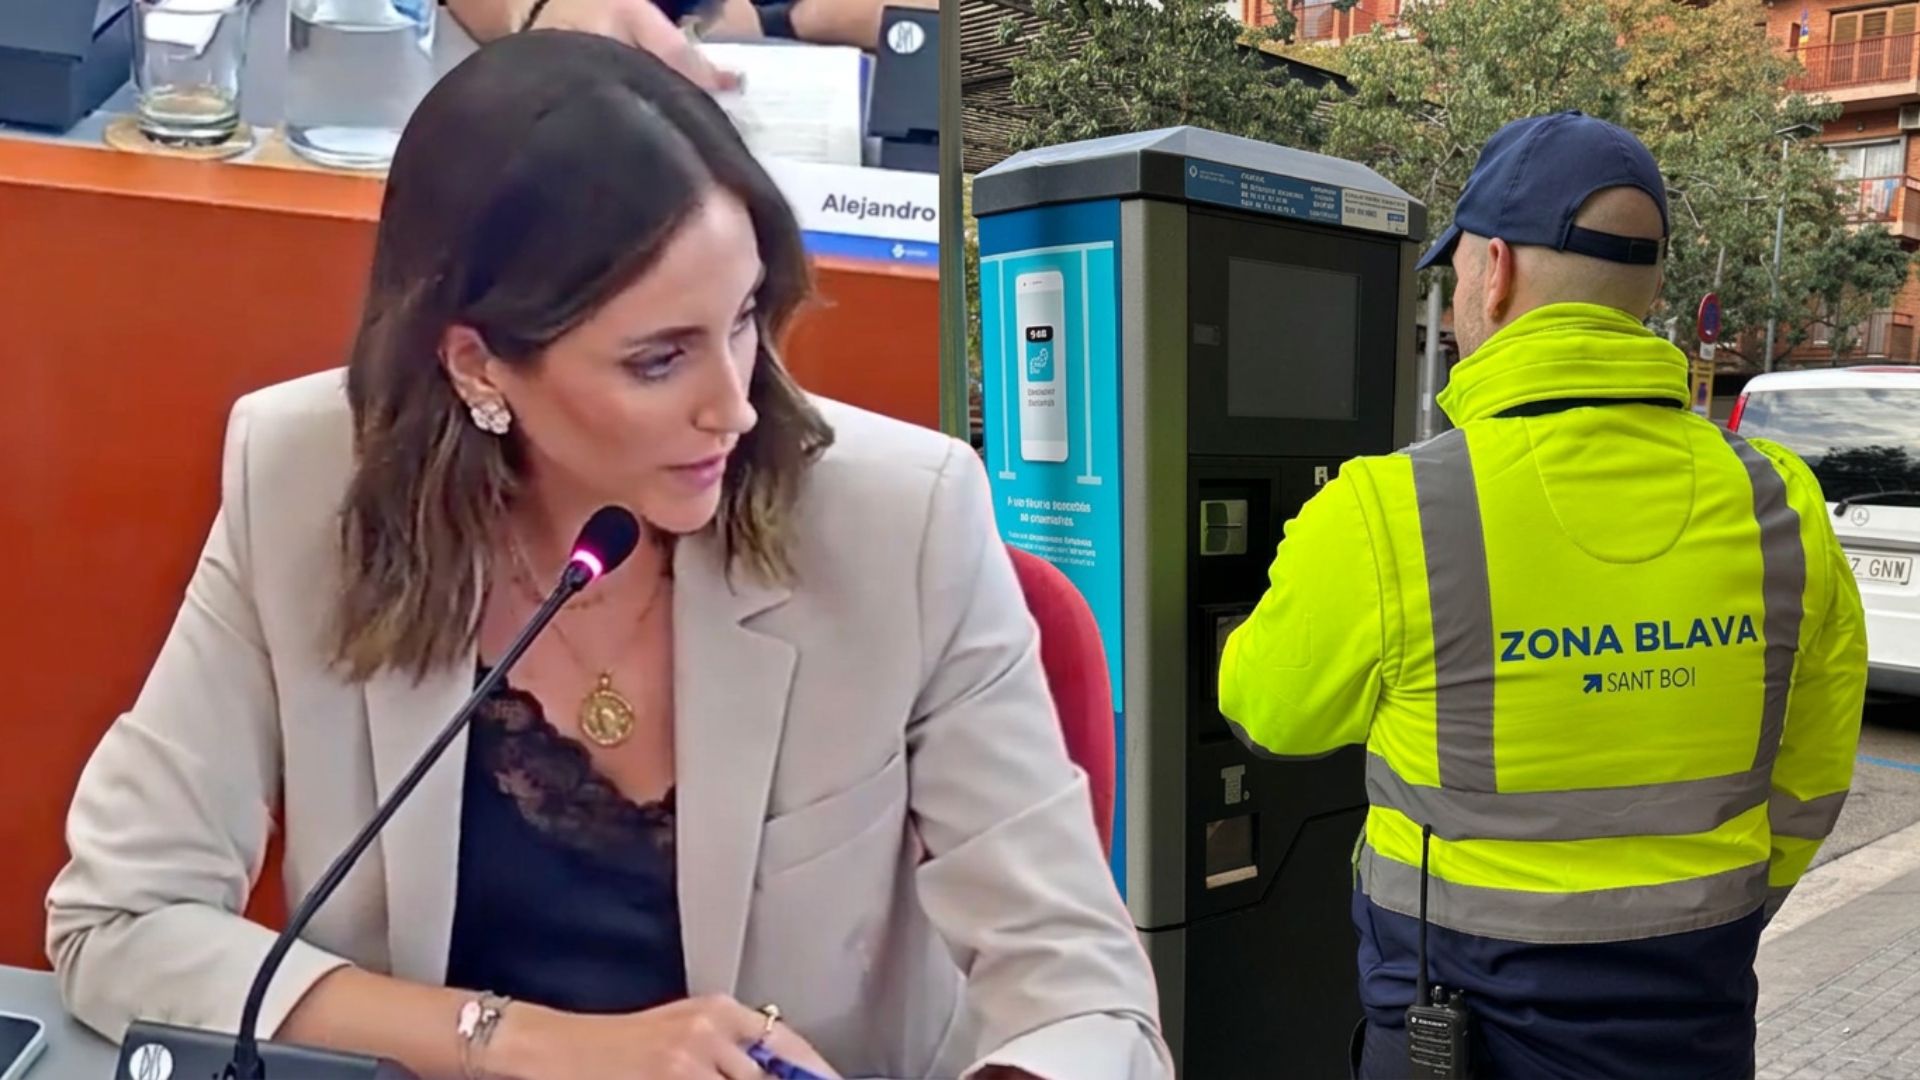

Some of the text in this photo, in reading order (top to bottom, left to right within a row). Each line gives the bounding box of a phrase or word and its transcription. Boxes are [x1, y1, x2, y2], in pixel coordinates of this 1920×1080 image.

[821, 193, 936, 222] Alejandro
[1869, 559, 1905, 579] GNN
[1500, 614, 1758, 663] ZONA BLAVA
[1606, 666, 1696, 693] SANT BOI
